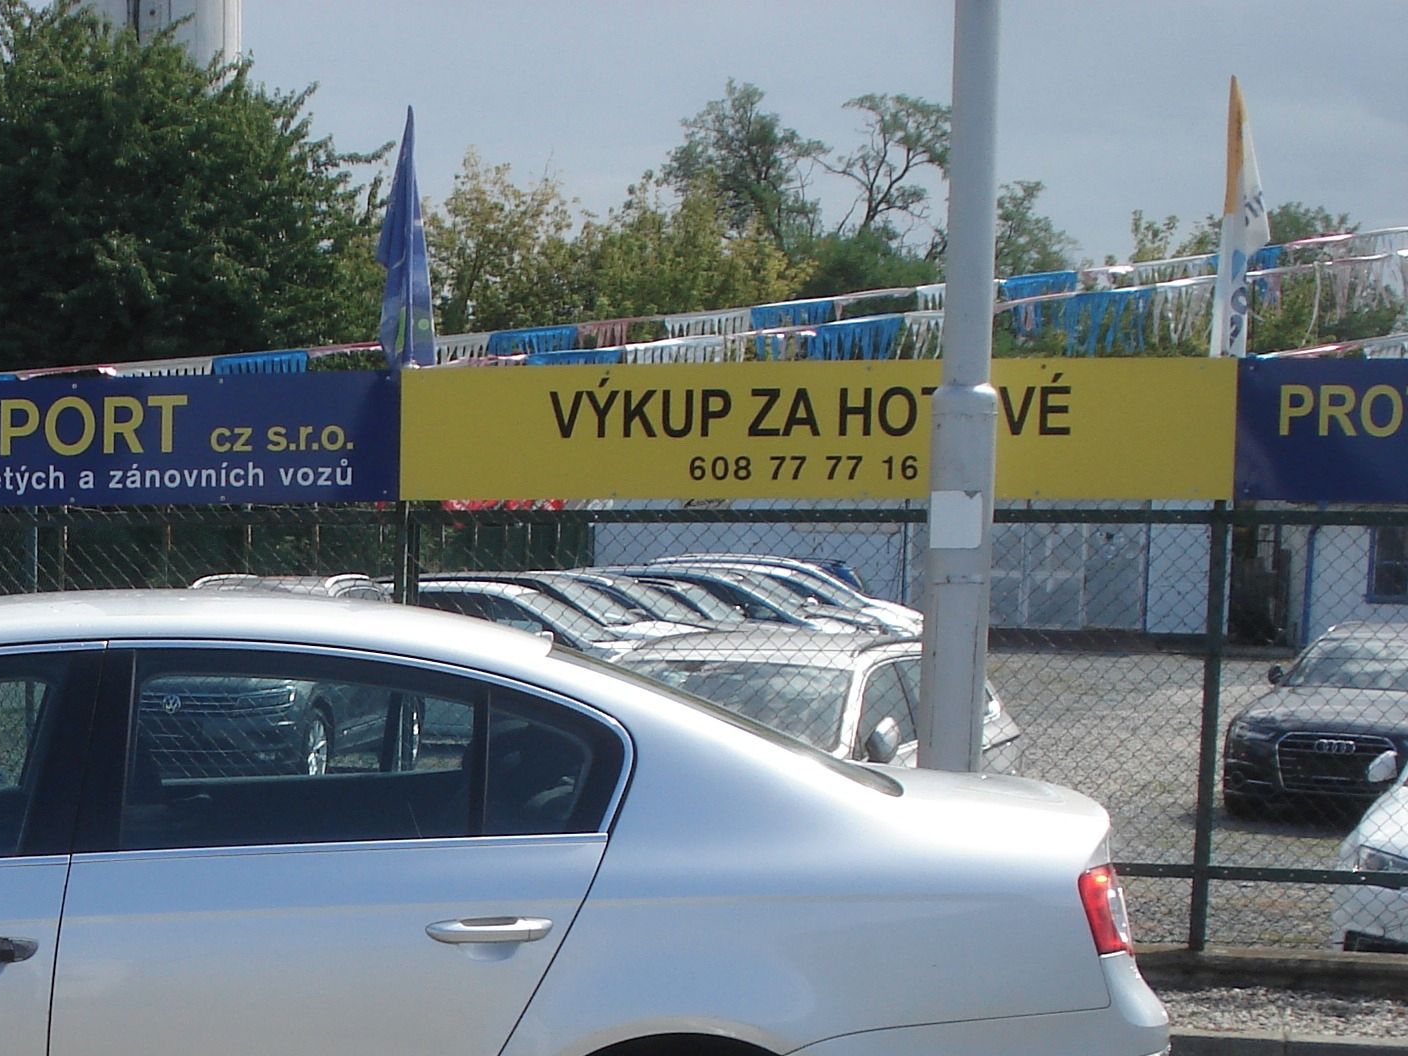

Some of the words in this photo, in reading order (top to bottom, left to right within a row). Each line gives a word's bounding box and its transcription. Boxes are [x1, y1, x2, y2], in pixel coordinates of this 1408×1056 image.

[549, 376, 733, 438] VÝKUP
[747, 387, 821, 437] ZA
[838, 372, 1072, 437] HOVÉ
[1279, 384, 1408, 438] PRO
[210, 426, 253, 452] cz
[266, 425, 354, 451] s.r.o.
[78, 471, 95, 490] a
[108, 462, 265, 489] zánovních
[279, 458, 354, 486] vozů
[688, 455, 753, 481] 608
[768, 455, 807, 481] 77
[825, 455, 863, 481] 77
[882, 455, 919, 481] 16
